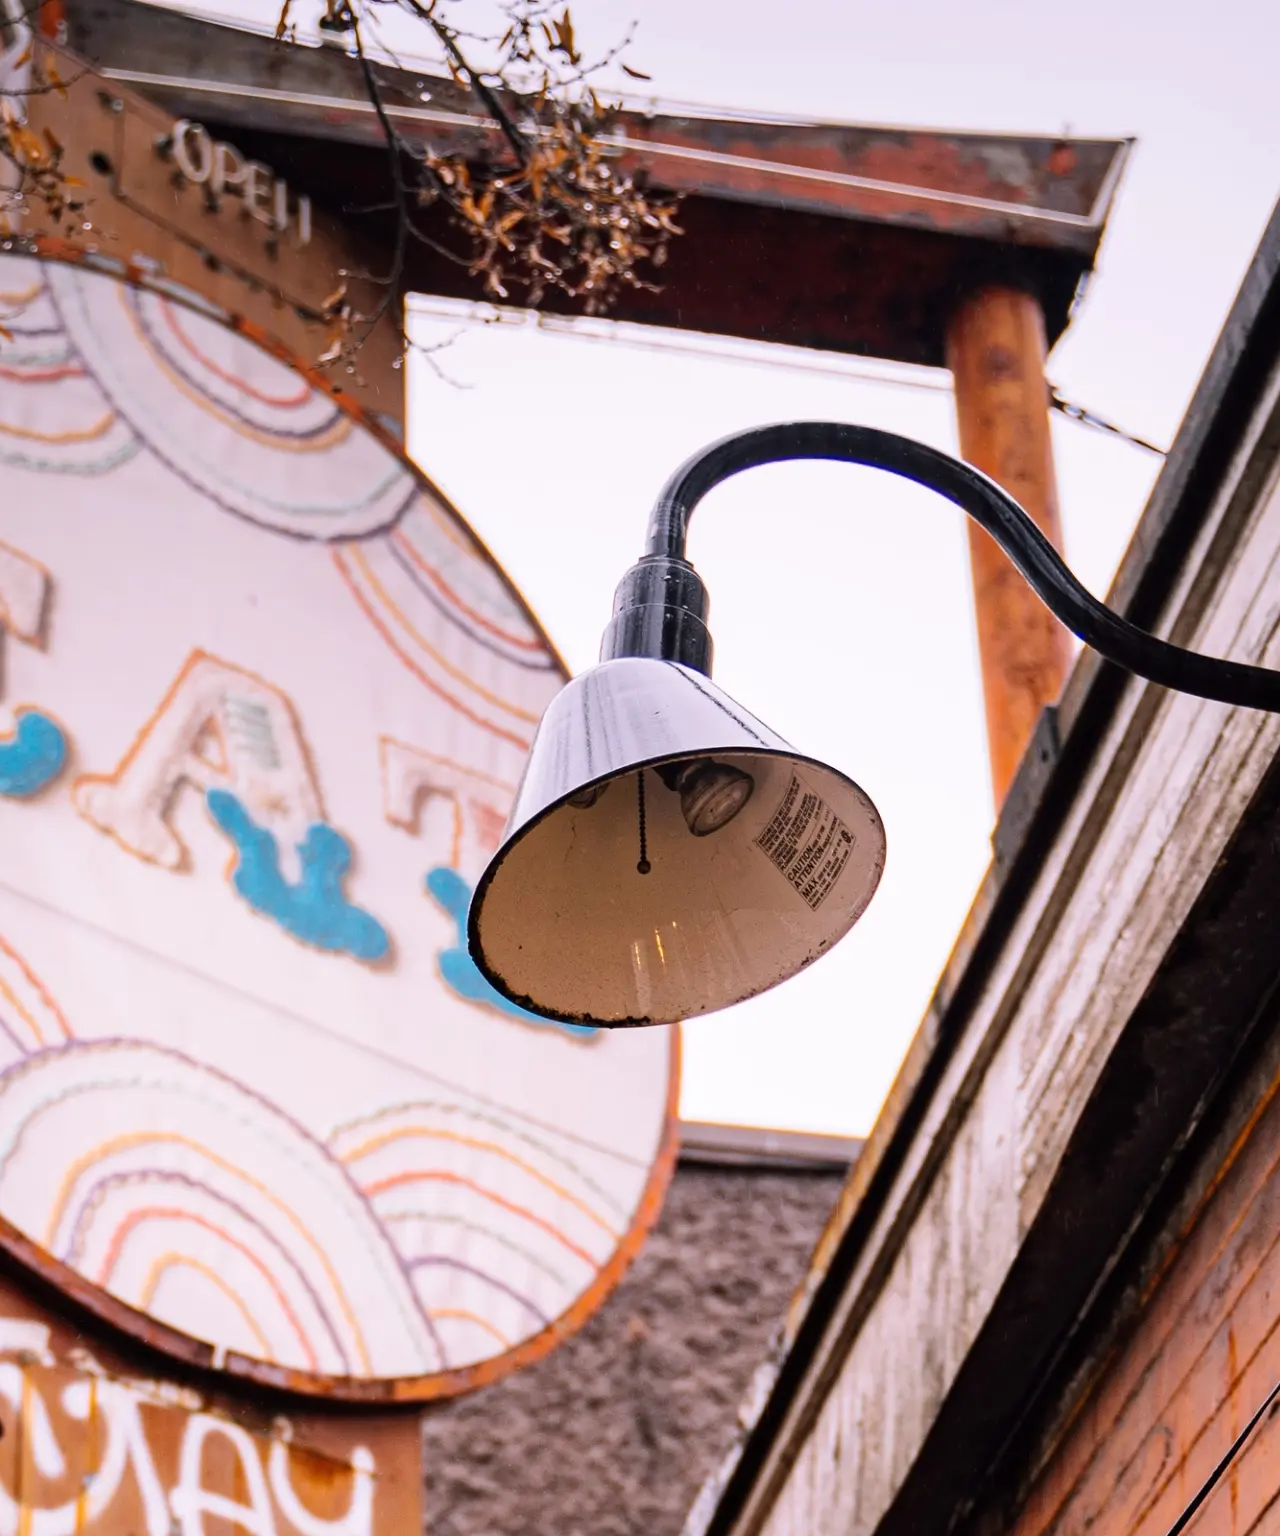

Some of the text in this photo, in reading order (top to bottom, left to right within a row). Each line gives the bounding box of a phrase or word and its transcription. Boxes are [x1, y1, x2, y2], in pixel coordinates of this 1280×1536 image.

[787, 845, 814, 881] CAUTION
[794, 845, 824, 889] ATTENTION
[801, 876, 819, 899] MAX
